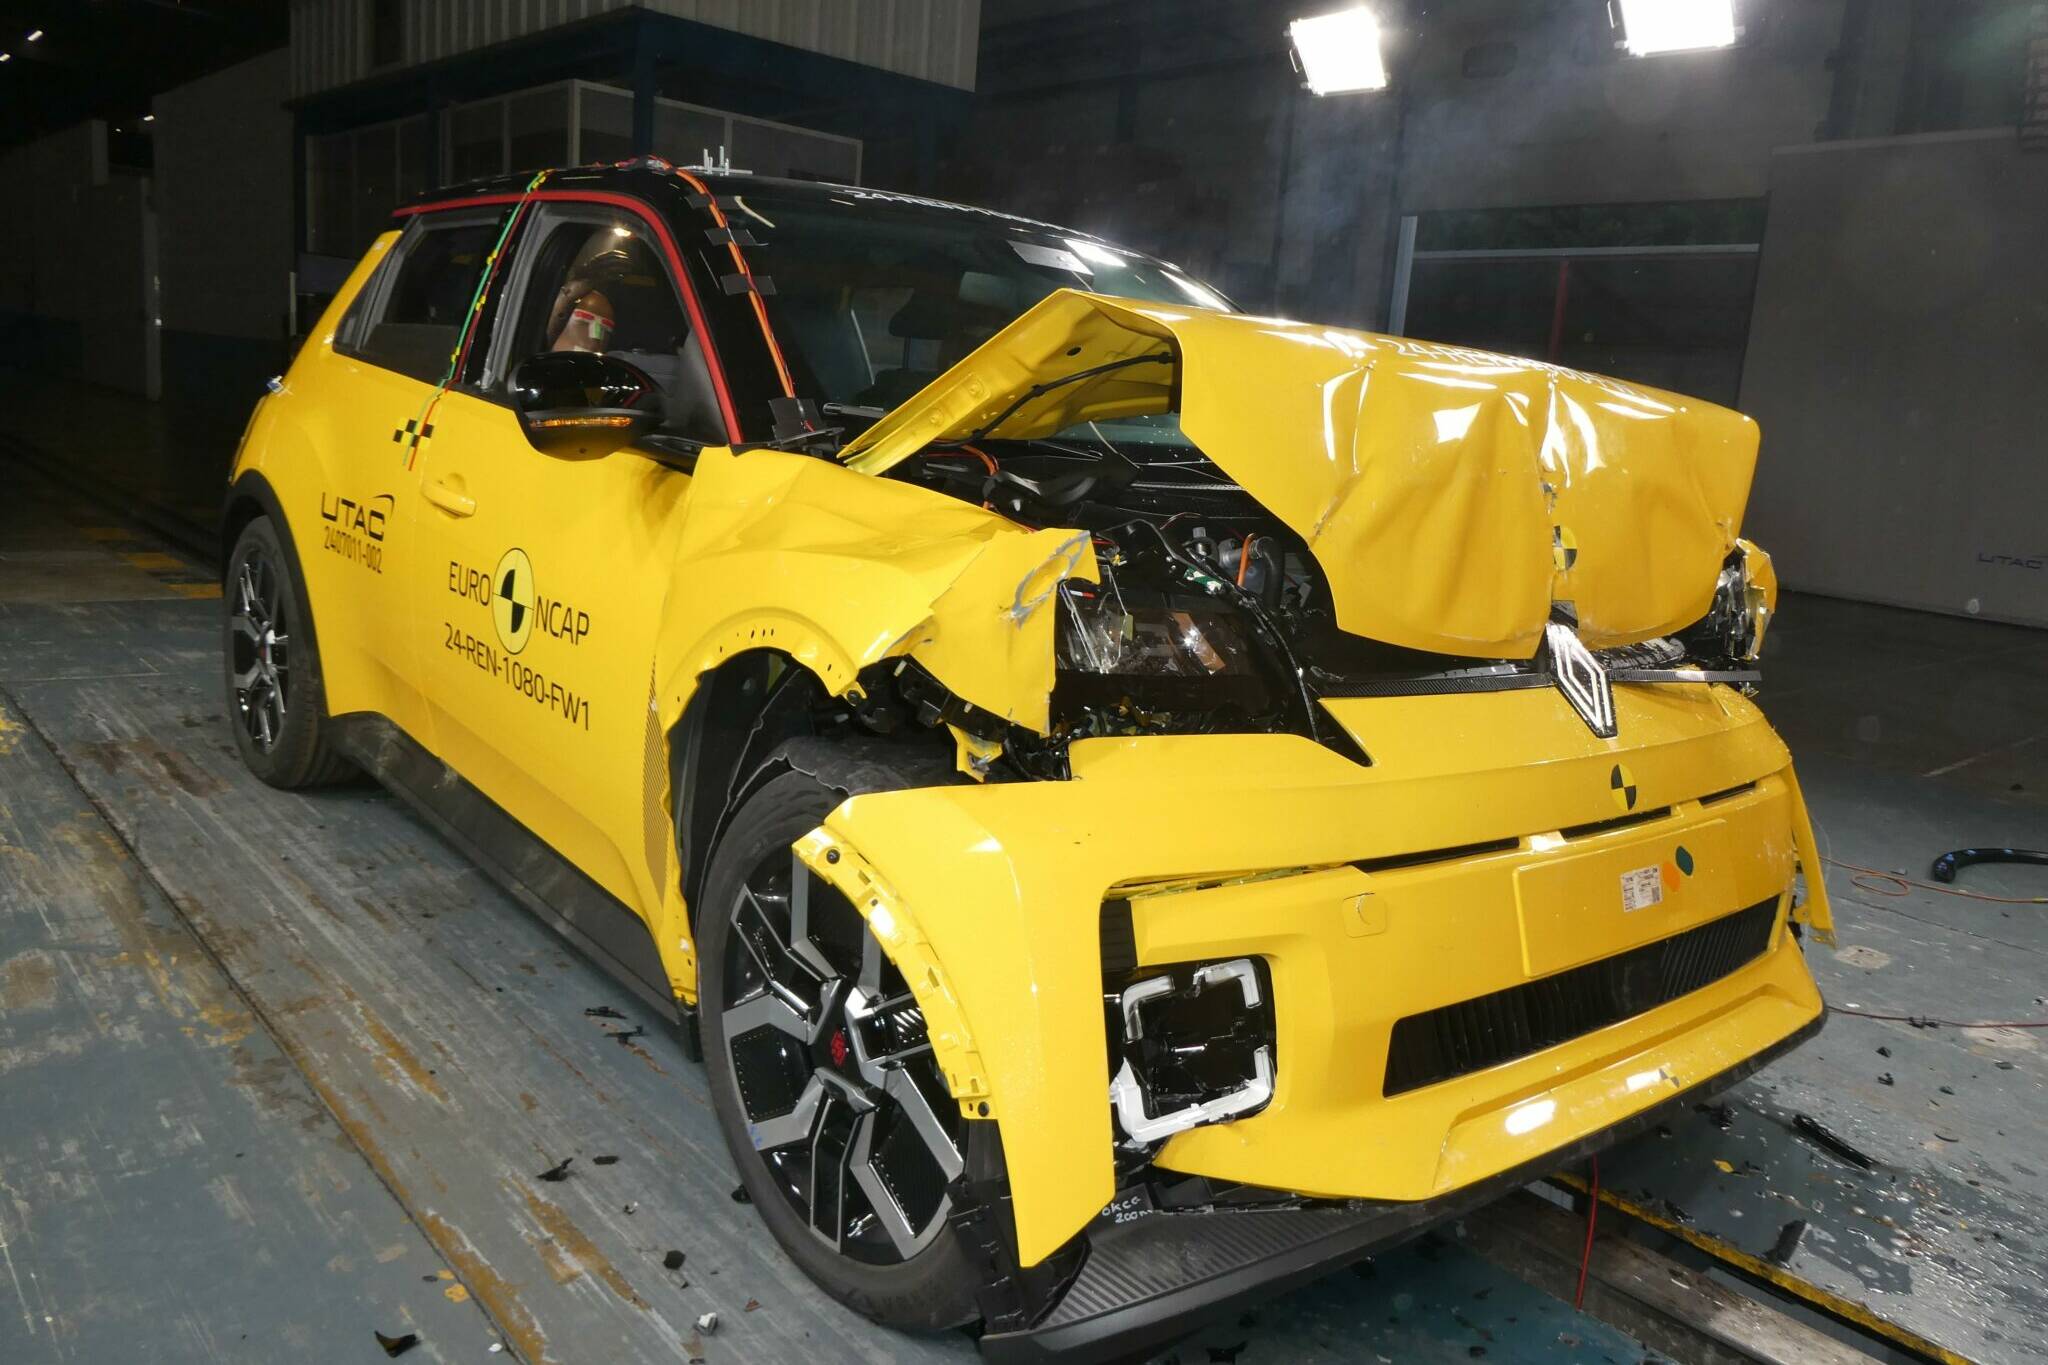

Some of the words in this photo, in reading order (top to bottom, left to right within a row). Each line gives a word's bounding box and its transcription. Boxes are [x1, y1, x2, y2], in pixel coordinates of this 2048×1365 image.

[321, 491, 387, 542] UTAC
[1979, 552, 2043, 570] UTAC
[449, 560, 491, 607] EURO
[535, 594, 590, 646] NCAP
[445, 621, 590, 732] 24-REN-1080-FW1
